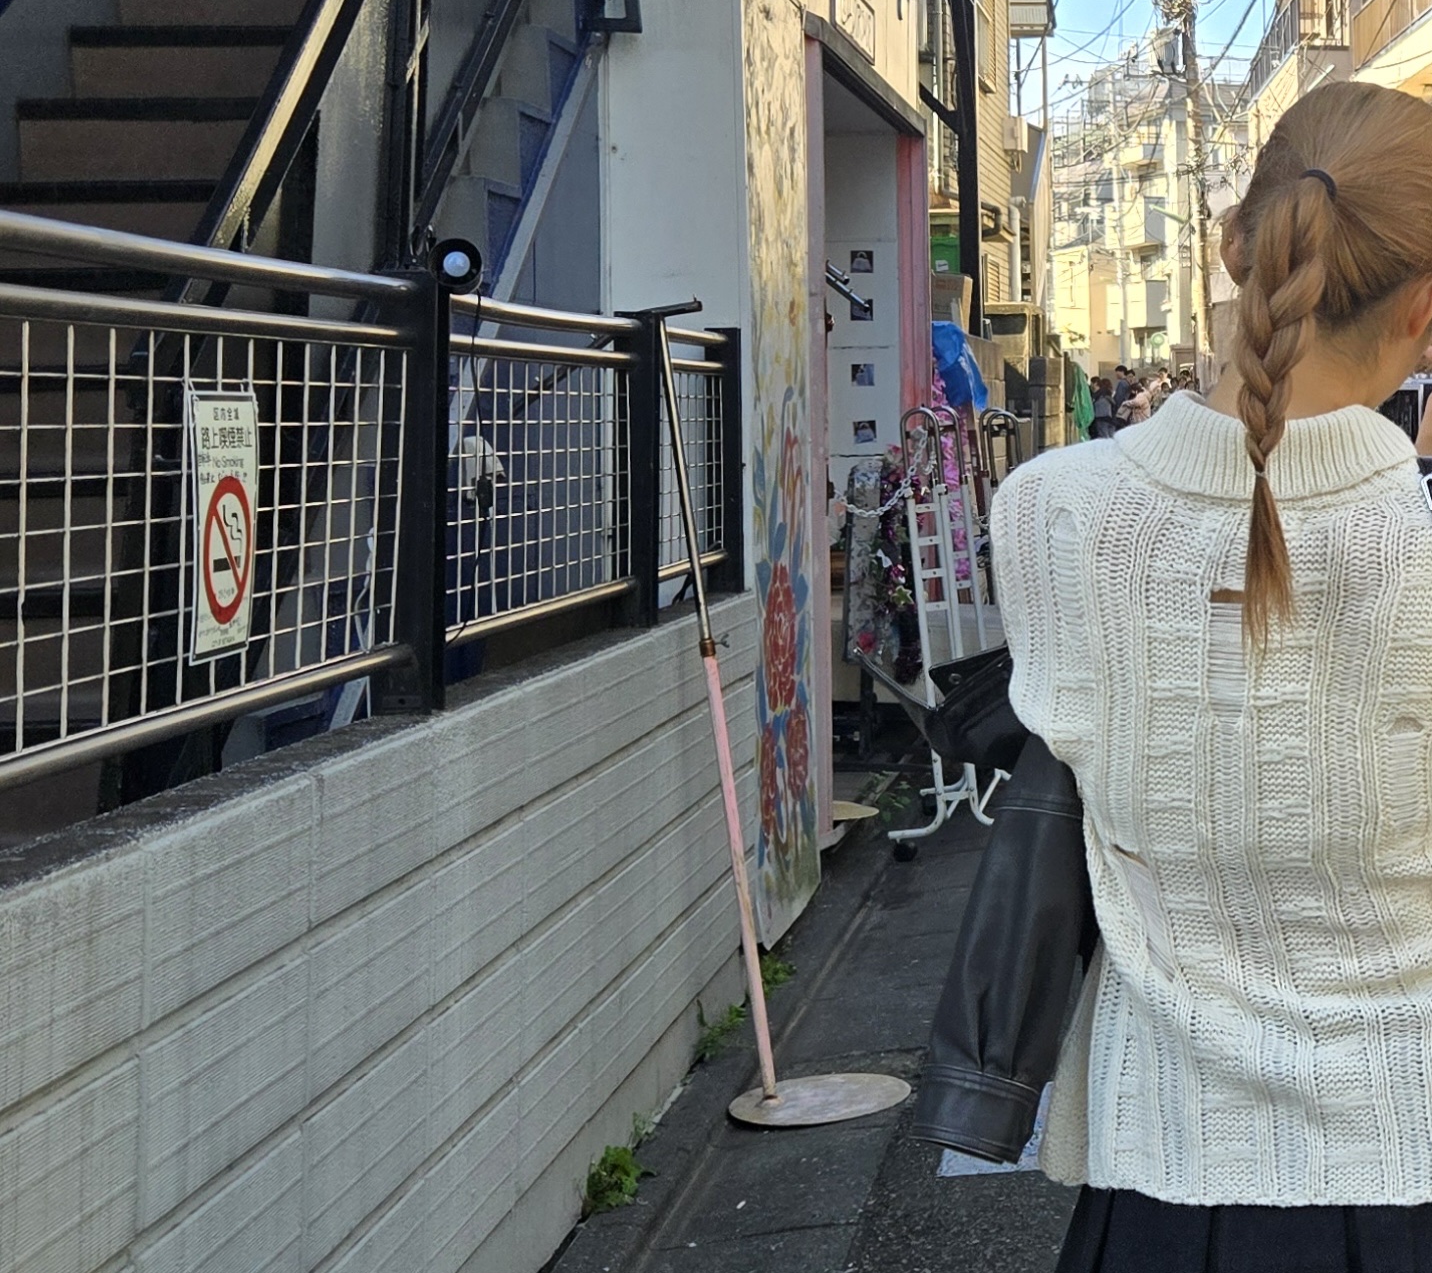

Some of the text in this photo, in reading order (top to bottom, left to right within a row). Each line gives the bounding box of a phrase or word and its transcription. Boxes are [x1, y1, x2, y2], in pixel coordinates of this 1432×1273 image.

[201, 427, 253, 450] 路上喫煙禁止
